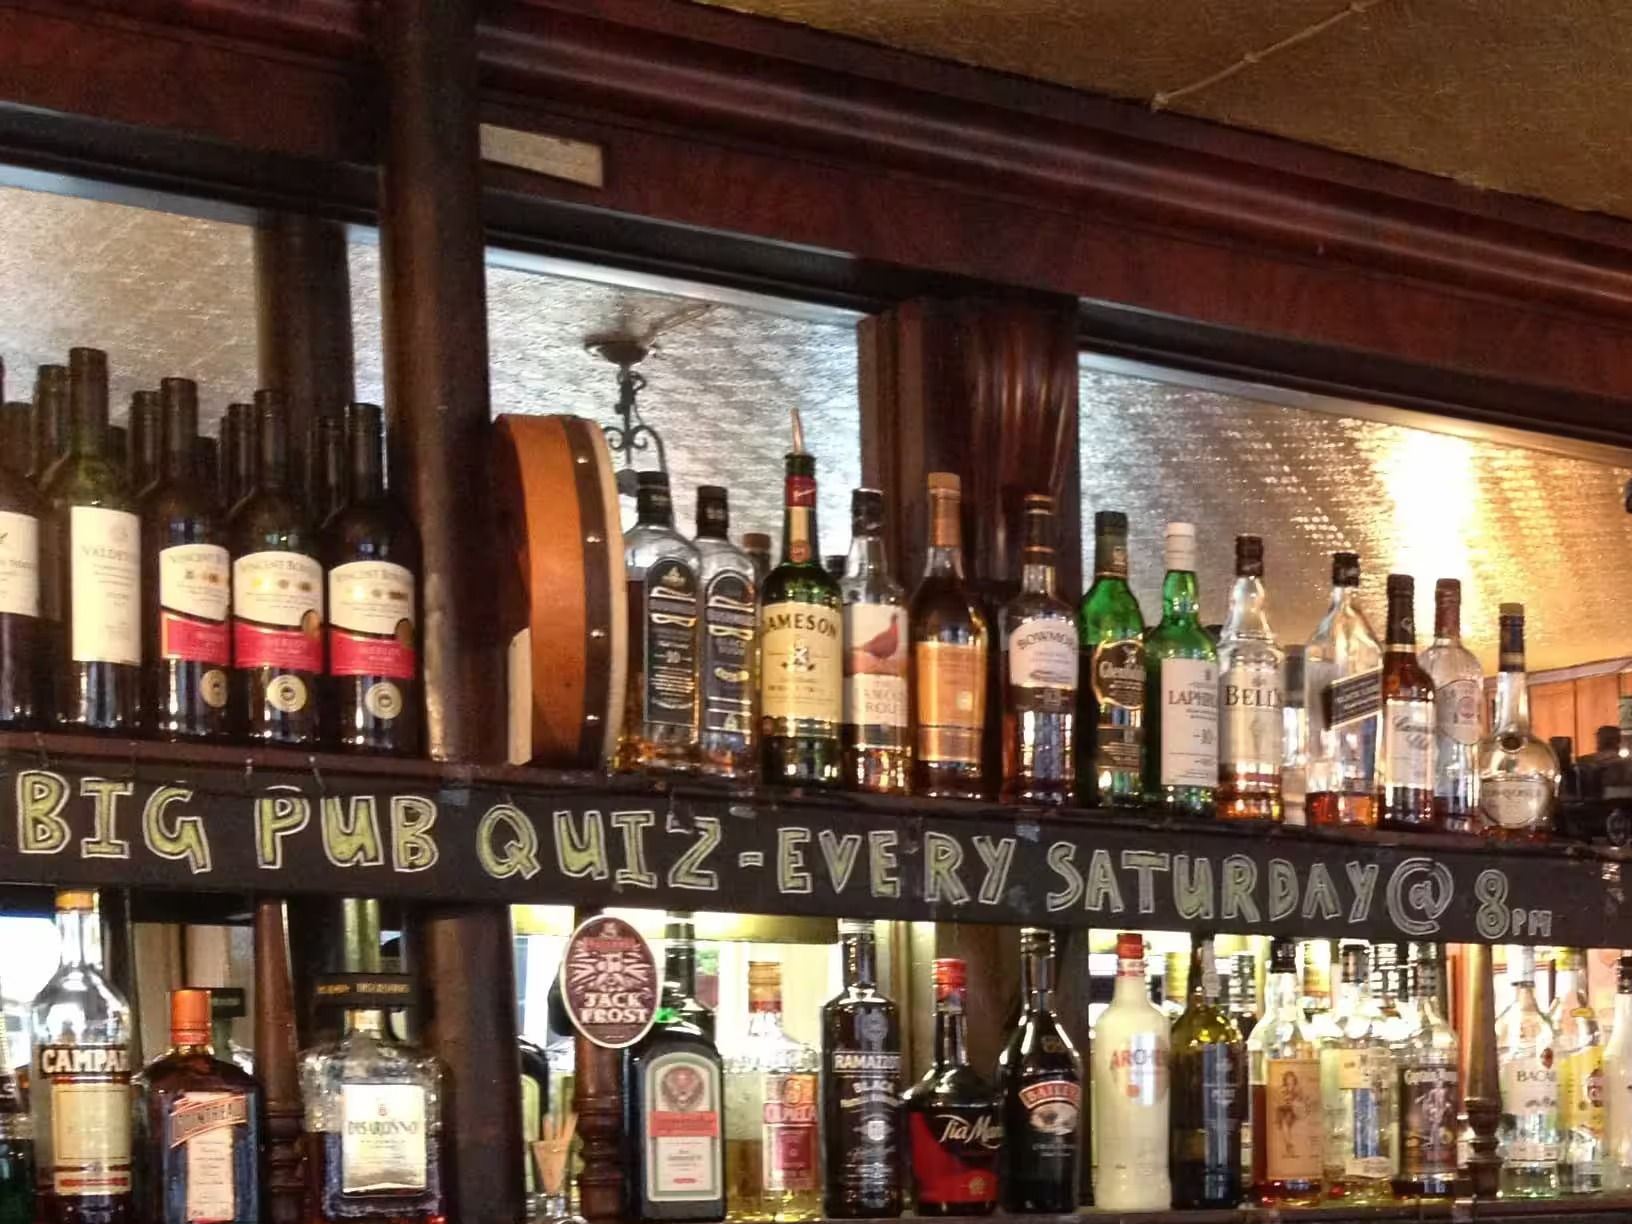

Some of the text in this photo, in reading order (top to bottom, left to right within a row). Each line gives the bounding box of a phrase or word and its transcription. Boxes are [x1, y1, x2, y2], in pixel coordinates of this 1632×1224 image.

[762, 613, 837, 637] JAMESON
[16, 769, 213, 874] BIG
[254, 785, 440, 873] PUB
[583, 992, 641, 1009] JACK
[579, 1008, 648, 1024] FROST
